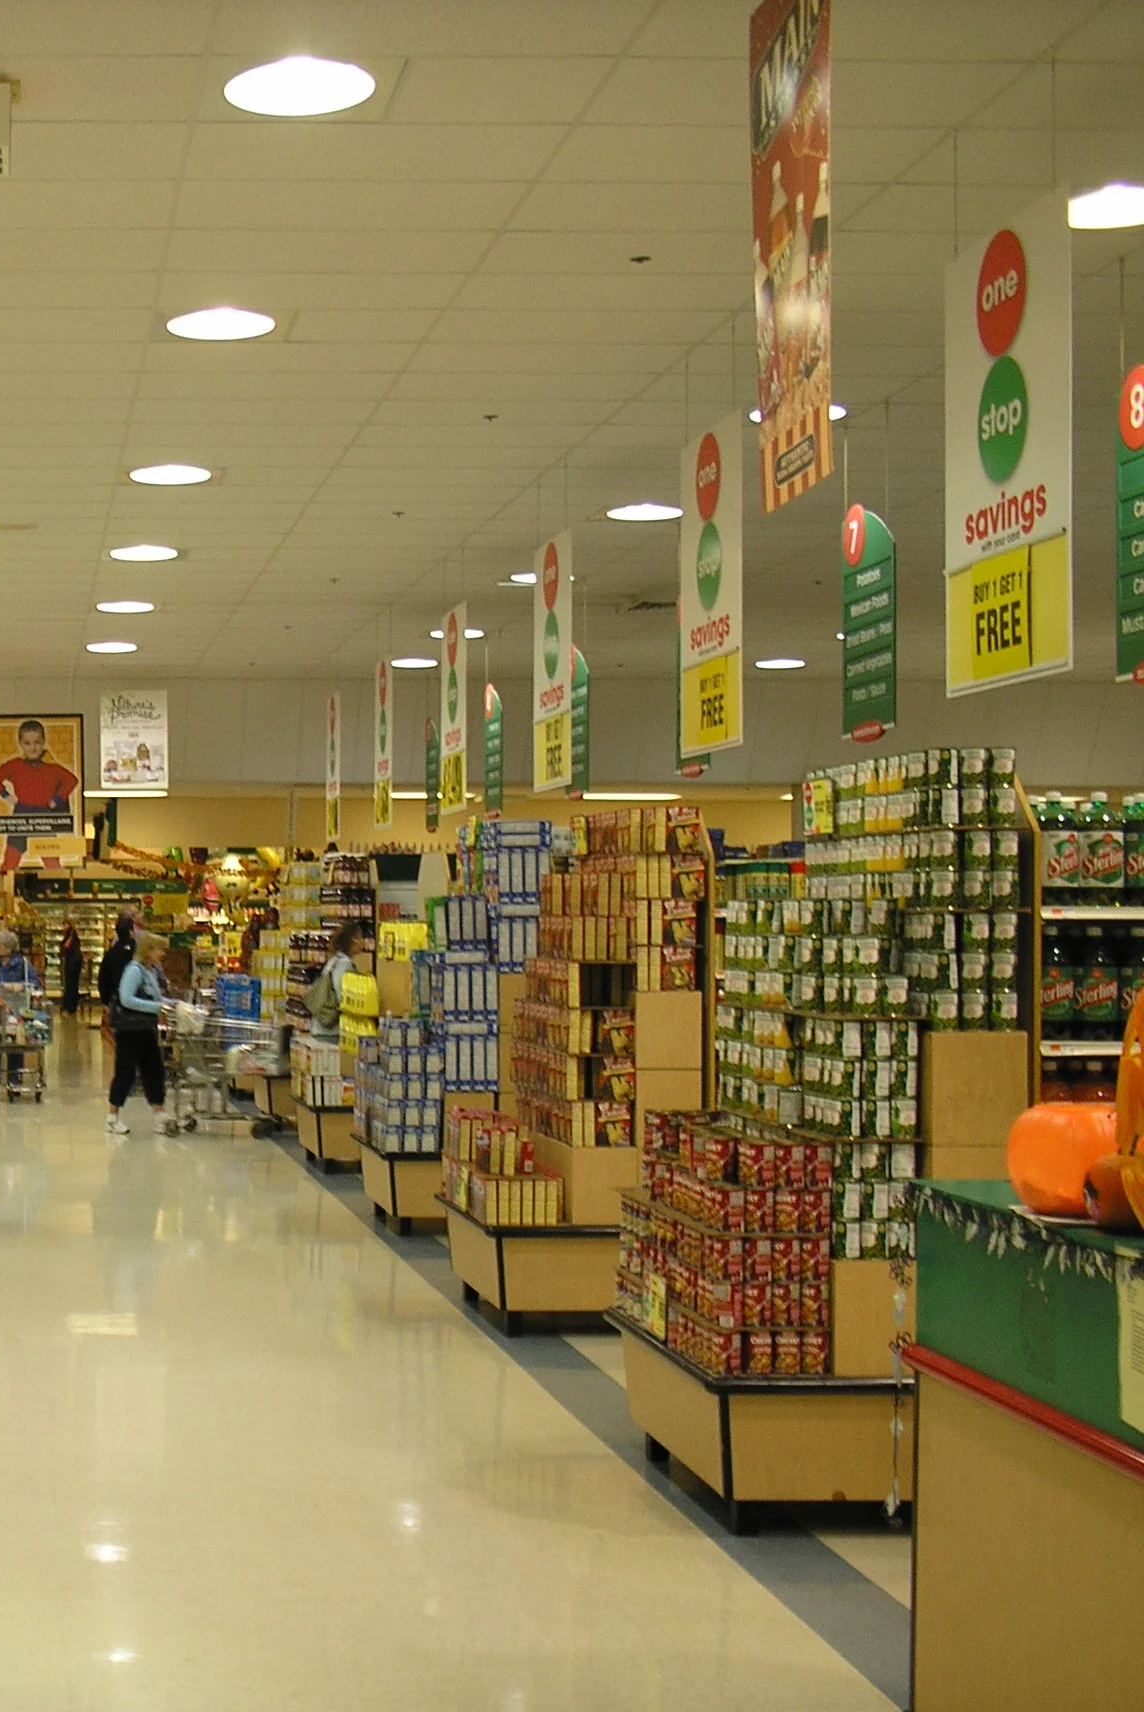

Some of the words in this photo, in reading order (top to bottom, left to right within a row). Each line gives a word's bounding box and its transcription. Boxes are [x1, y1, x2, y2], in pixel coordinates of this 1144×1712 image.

[982, 269, 1018, 313] one
[981, 398, 1022, 441] stop
[1130, 383, 1144, 429] 8
[965, 484, 1047, 545] savings
[848, 519, 859, 555] 7
[973, 579, 990, 604] BUY
[993, 578, 998, 599] 1
[999, 573, 1016, 597] GET
[1018, 570, 1023, 591] 1
[690, 613, 730, 650] savings
[975, 600, 1022, 656] FREE
[700, 693, 724, 730] FREE
